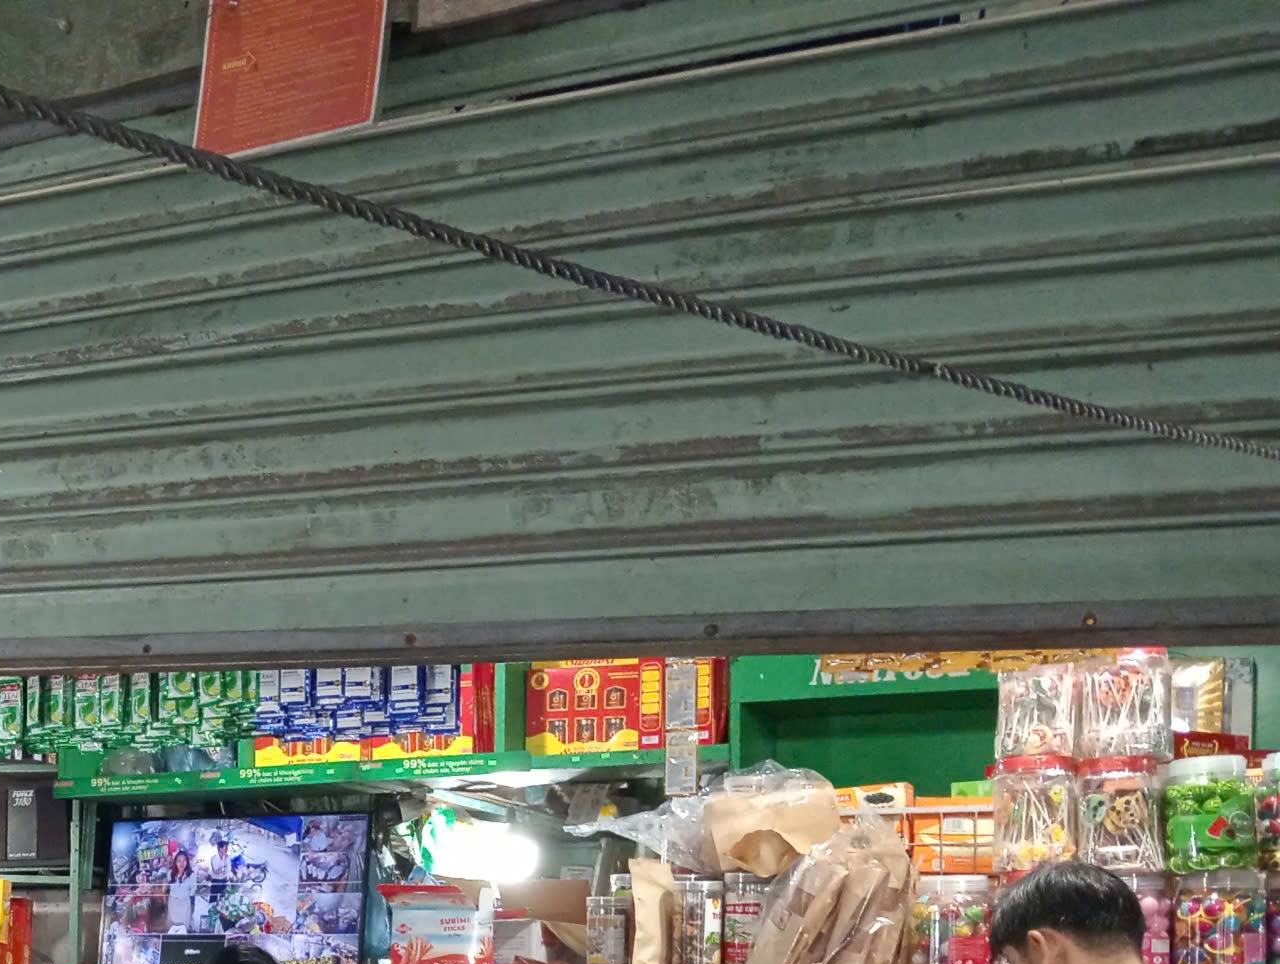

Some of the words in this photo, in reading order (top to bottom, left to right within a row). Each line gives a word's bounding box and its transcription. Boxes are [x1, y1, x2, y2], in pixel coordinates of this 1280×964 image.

[403, 758, 427, 768] 99%
[239, 768, 261, 778] 99%
[90, 778, 110, 787] 99%
